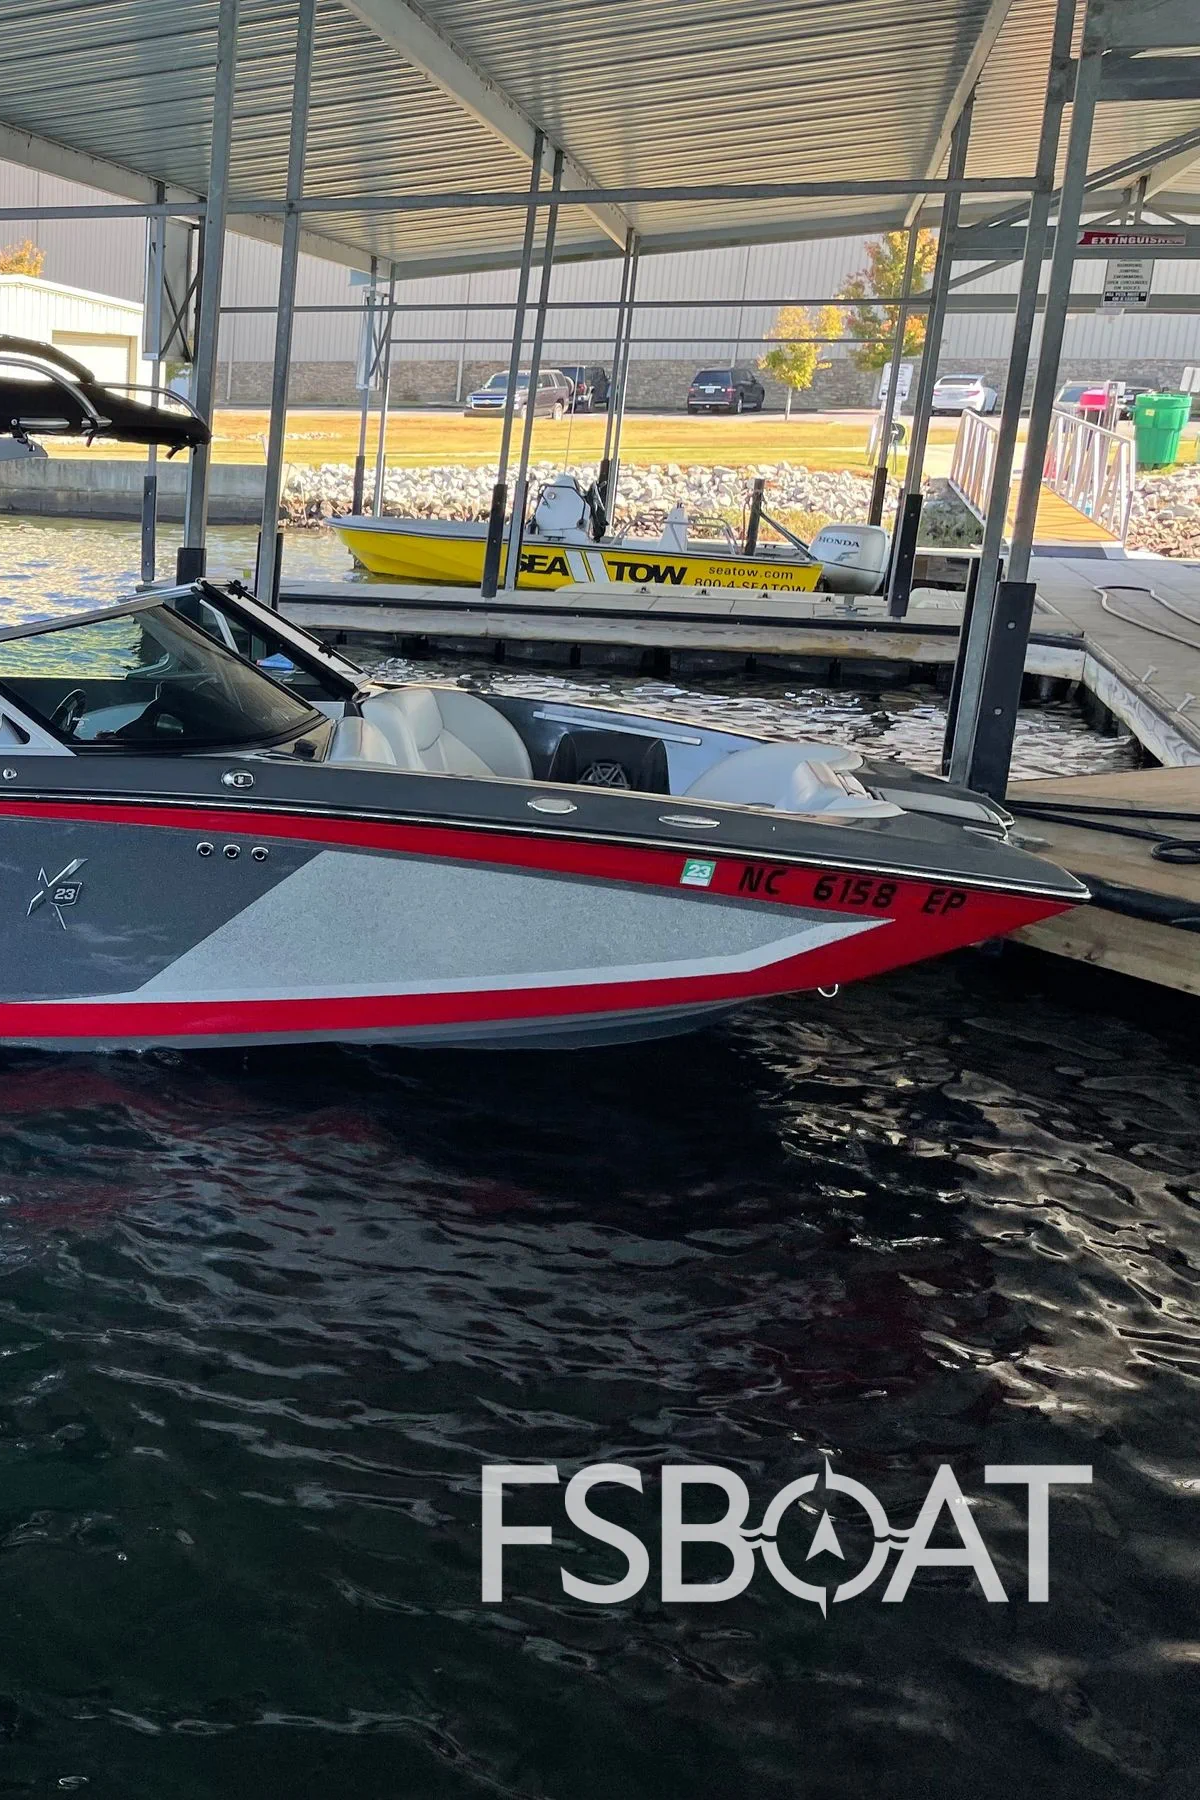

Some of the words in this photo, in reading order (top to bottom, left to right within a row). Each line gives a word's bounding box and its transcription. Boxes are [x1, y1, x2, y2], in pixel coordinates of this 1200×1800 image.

[818, 535, 860, 547] HONDA
[608, 561, 687, 584] TOW
[708, 566, 794, 580] seatow.com
[687, 863, 711, 878] 23
[738, 866, 787, 895] NC
[812, 875, 898, 909] 6158
[920, 888, 968, 915] EP
